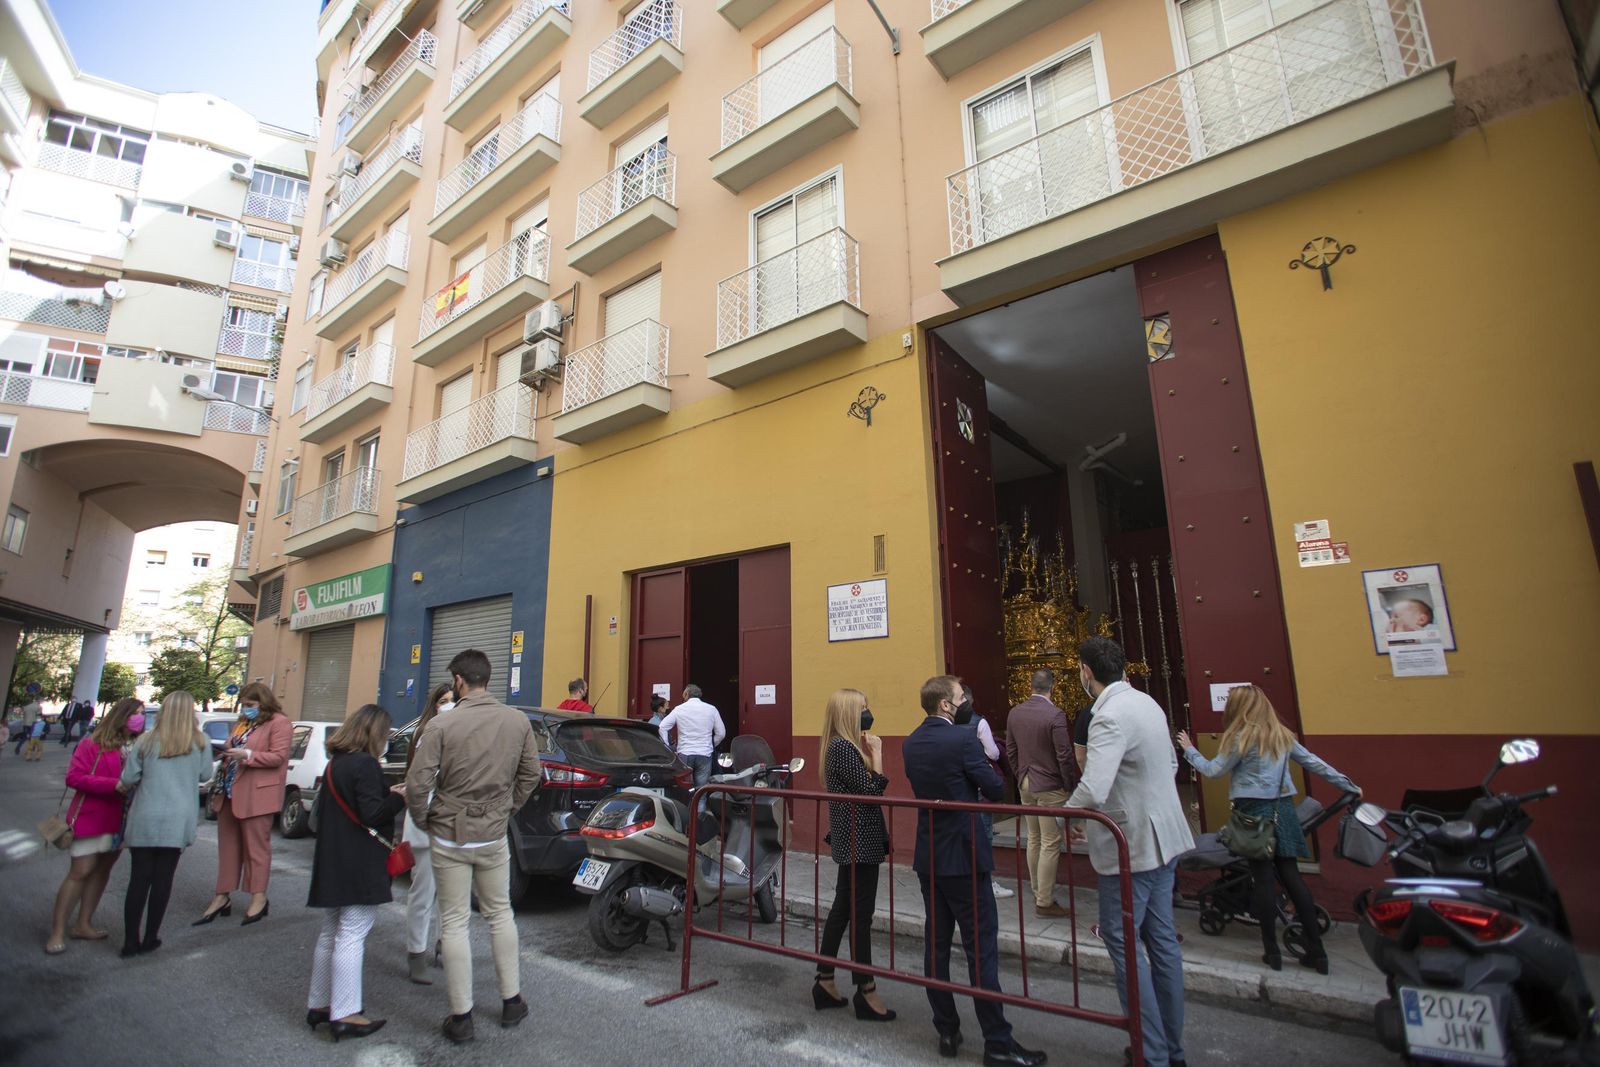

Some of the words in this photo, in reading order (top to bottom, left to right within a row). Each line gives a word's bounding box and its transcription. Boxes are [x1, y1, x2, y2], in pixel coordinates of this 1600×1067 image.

[317, 576, 362, 604] FUJIFILM
[585, 862, 607, 876] 6574
[1422, 994, 1490, 1025] 2042
[1438, 1022, 1485, 1051] JHW
